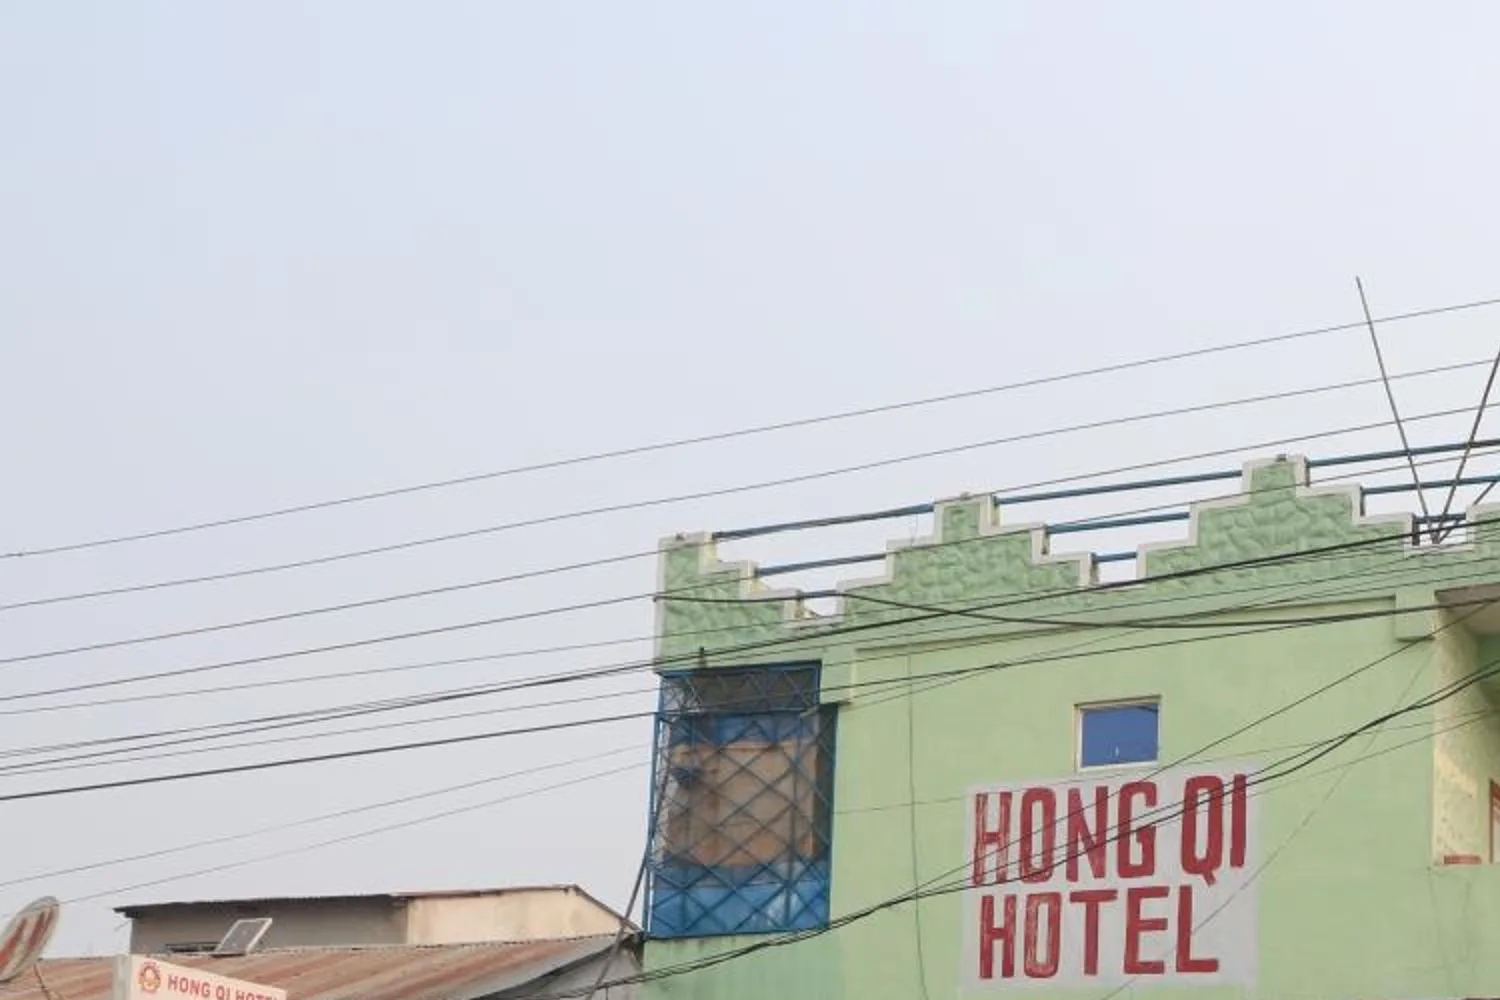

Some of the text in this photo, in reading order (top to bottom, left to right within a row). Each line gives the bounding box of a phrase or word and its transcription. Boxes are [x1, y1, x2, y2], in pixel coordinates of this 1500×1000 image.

[972, 774, 1247, 887] HONG QI
[979, 885, 1220, 980] HOTEL
[168, 974, 211, 998] HONG
